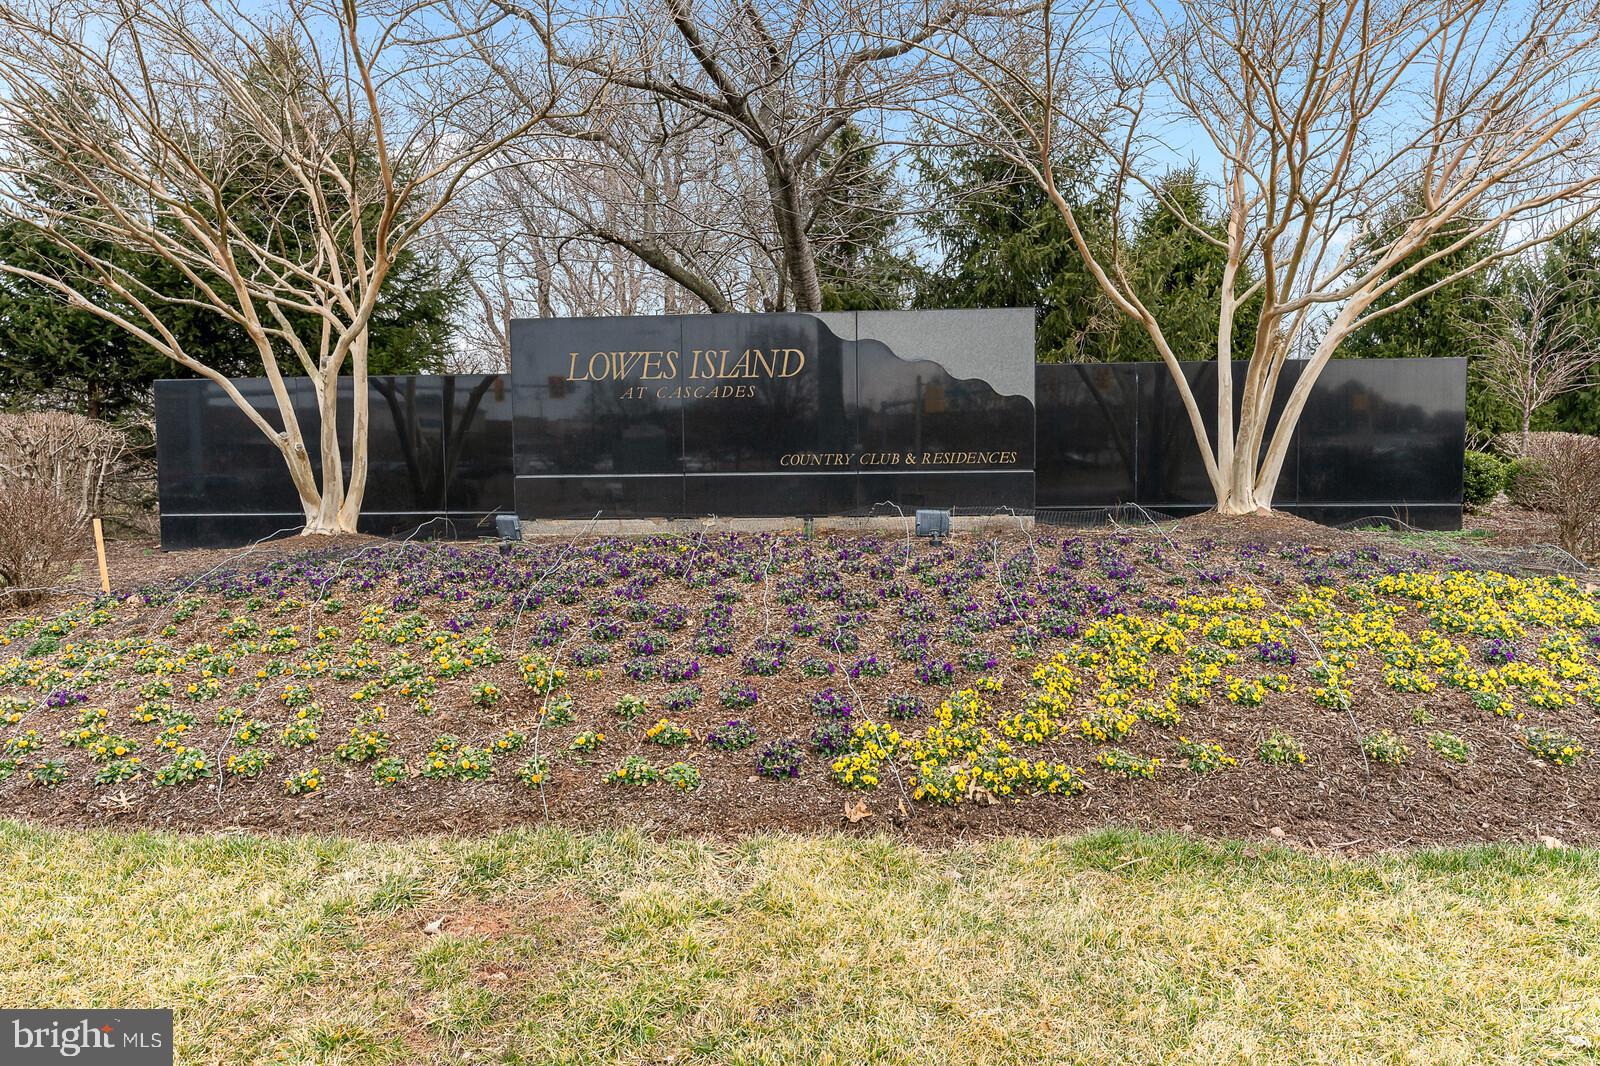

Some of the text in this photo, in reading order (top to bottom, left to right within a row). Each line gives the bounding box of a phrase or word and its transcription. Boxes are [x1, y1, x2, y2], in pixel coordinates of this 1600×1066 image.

[566, 348, 805, 381] LOWES ISLAND
[620, 385, 756, 399] AT CASCADES
[780, 451, 1017, 466] COUNTRY CLUB & RESIDENCES
